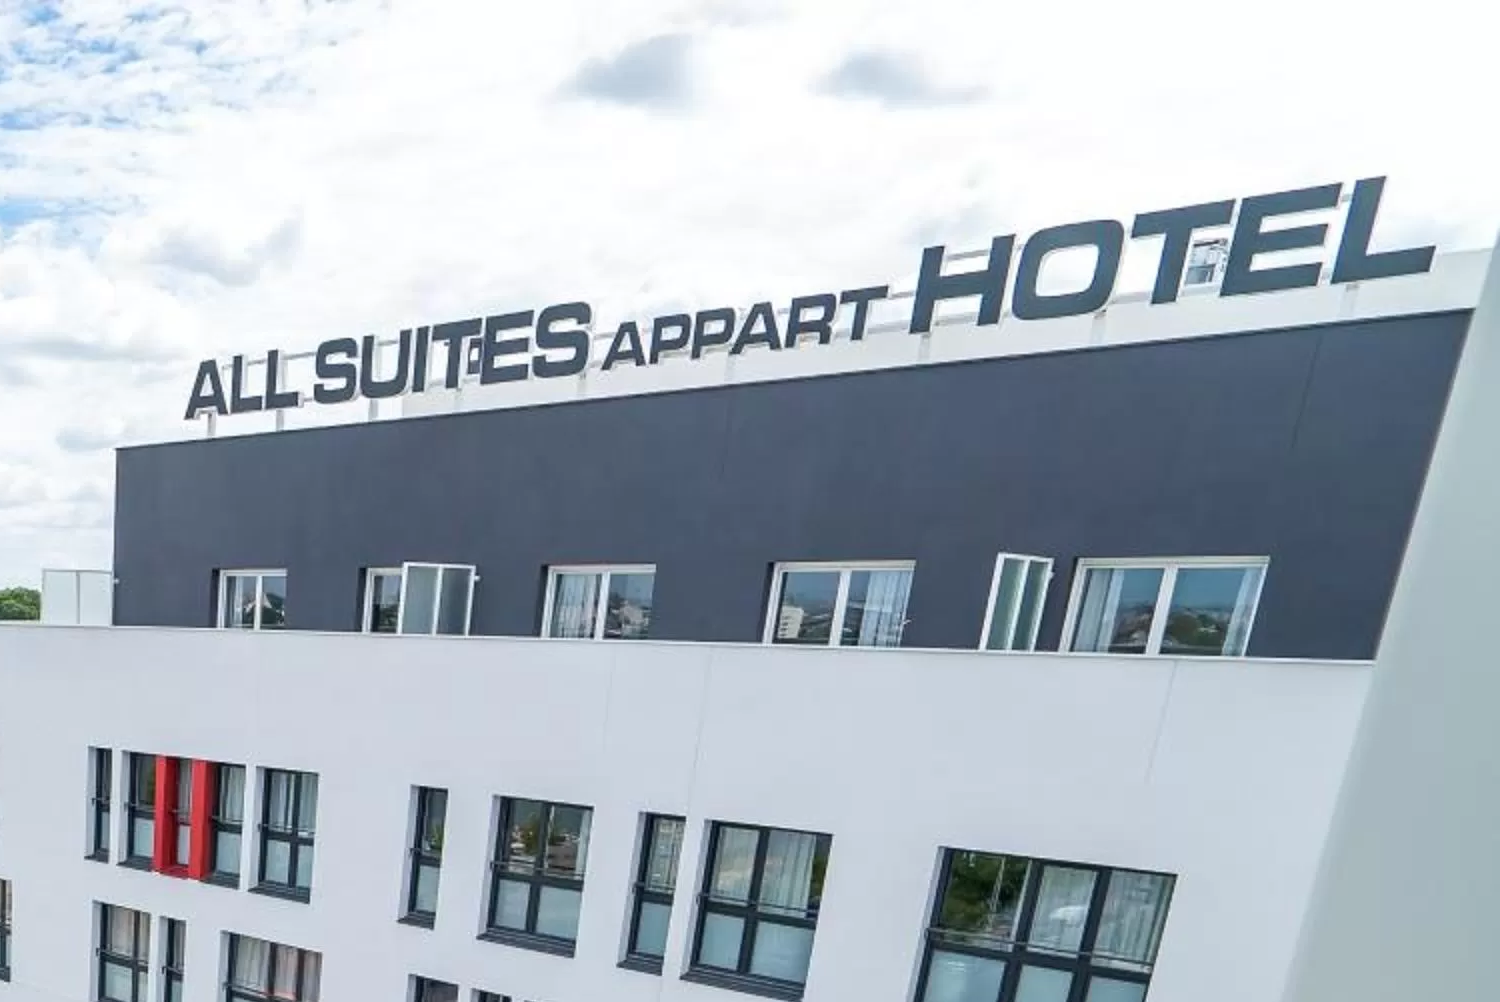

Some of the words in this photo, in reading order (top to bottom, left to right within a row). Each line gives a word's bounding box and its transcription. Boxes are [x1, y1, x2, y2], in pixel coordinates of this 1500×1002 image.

[184, 349, 299, 420] ALL
[313, 301, 591, 404] SUITES
[601, 285, 888, 370] APPART
[909, 175, 1436, 333] HOTEL
